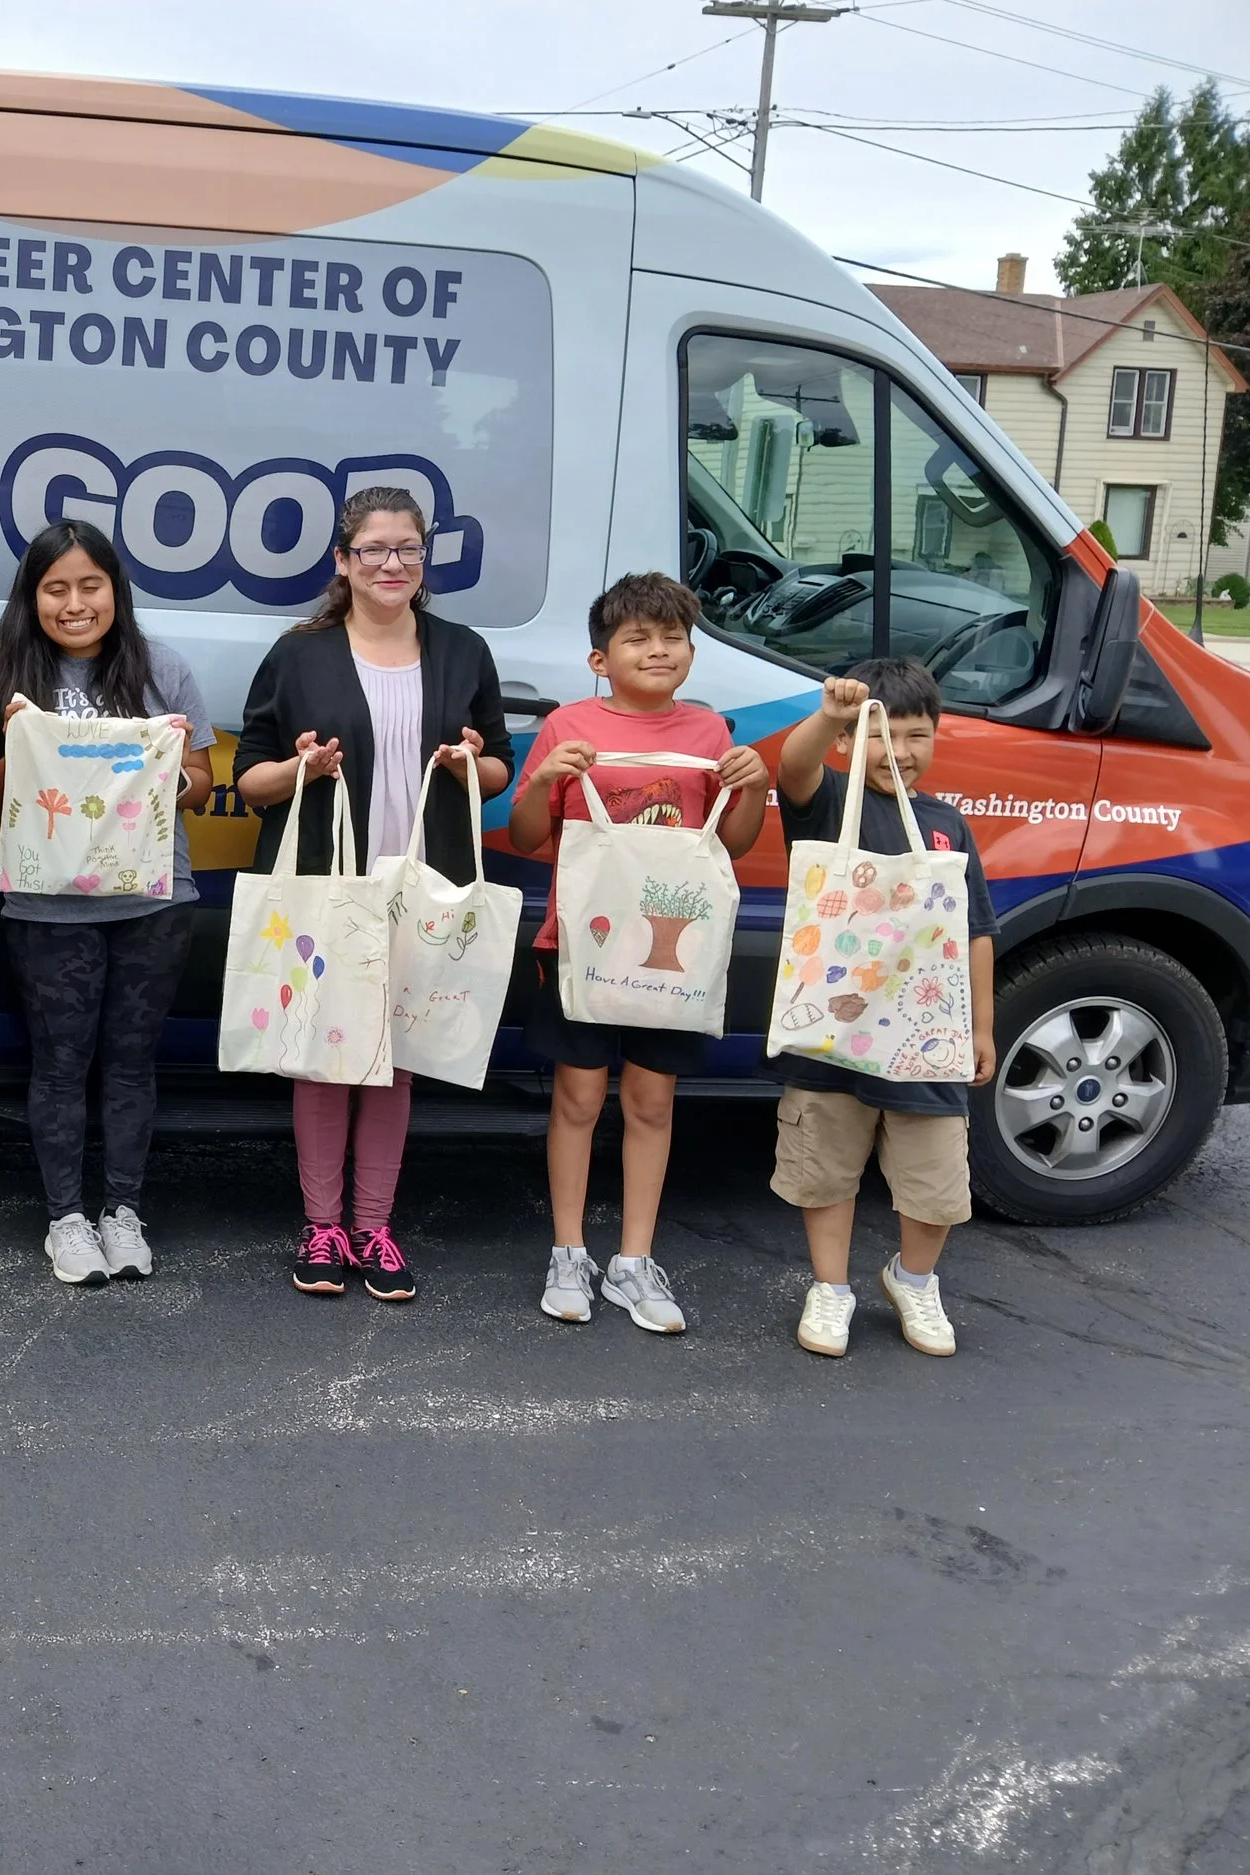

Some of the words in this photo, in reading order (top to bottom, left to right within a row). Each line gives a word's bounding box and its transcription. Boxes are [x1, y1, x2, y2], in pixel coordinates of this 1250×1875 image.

[112, 246, 363, 315] CENTER
[381, 266, 464, 320] OF
[186, 321, 462, 388] COUNTY
[52, 687, 90, 710] It's
[935, 792, 1087, 824] Washington
[1093, 799, 1182, 831] County
[585, 965, 618, 986] Have
[631, 980, 667, 993] Great
[670, 985, 707, 1002] Day!!!
[918, 1027, 948, 1041] GREAT
